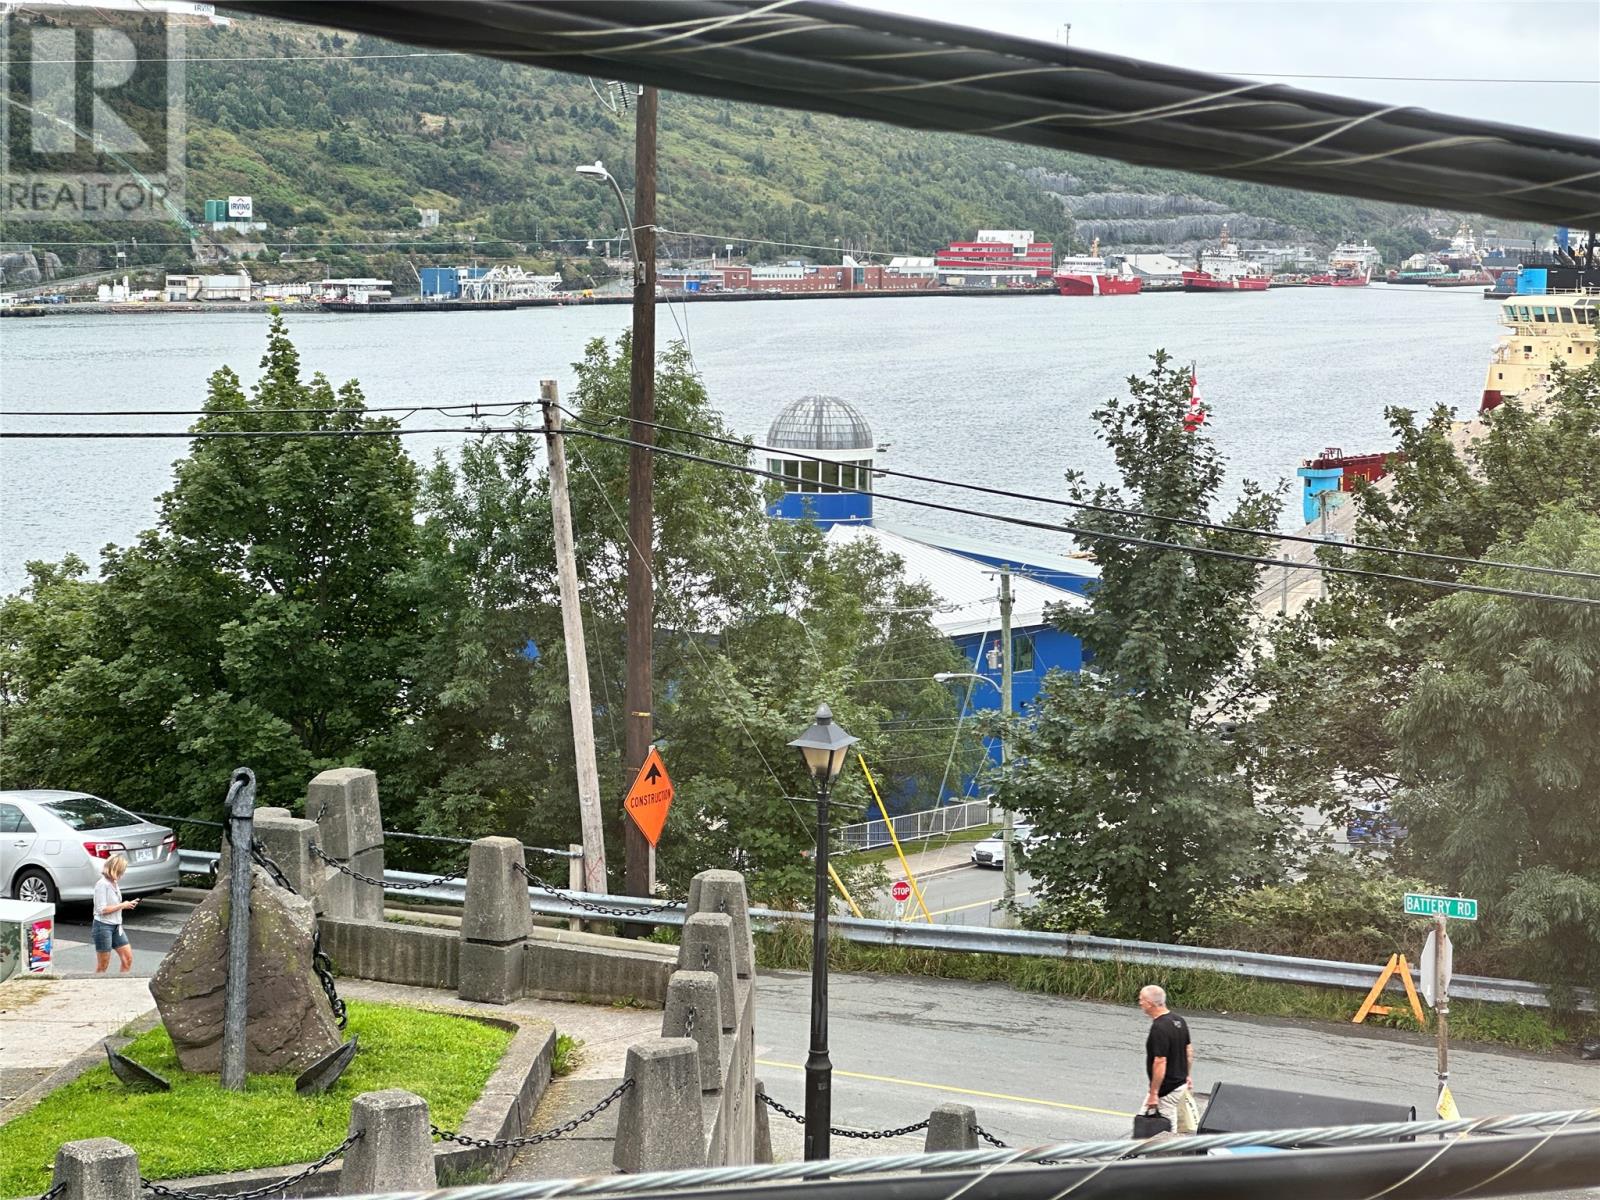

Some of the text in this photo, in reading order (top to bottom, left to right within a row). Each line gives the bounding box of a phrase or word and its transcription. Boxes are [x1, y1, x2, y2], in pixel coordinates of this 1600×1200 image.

[230, 202, 251, 210] IRVING
[630, 788, 671, 809] CONSTRUCTION
[893, 887, 910, 896] STOP
[1406, 896, 1451, 914] BATTERY
